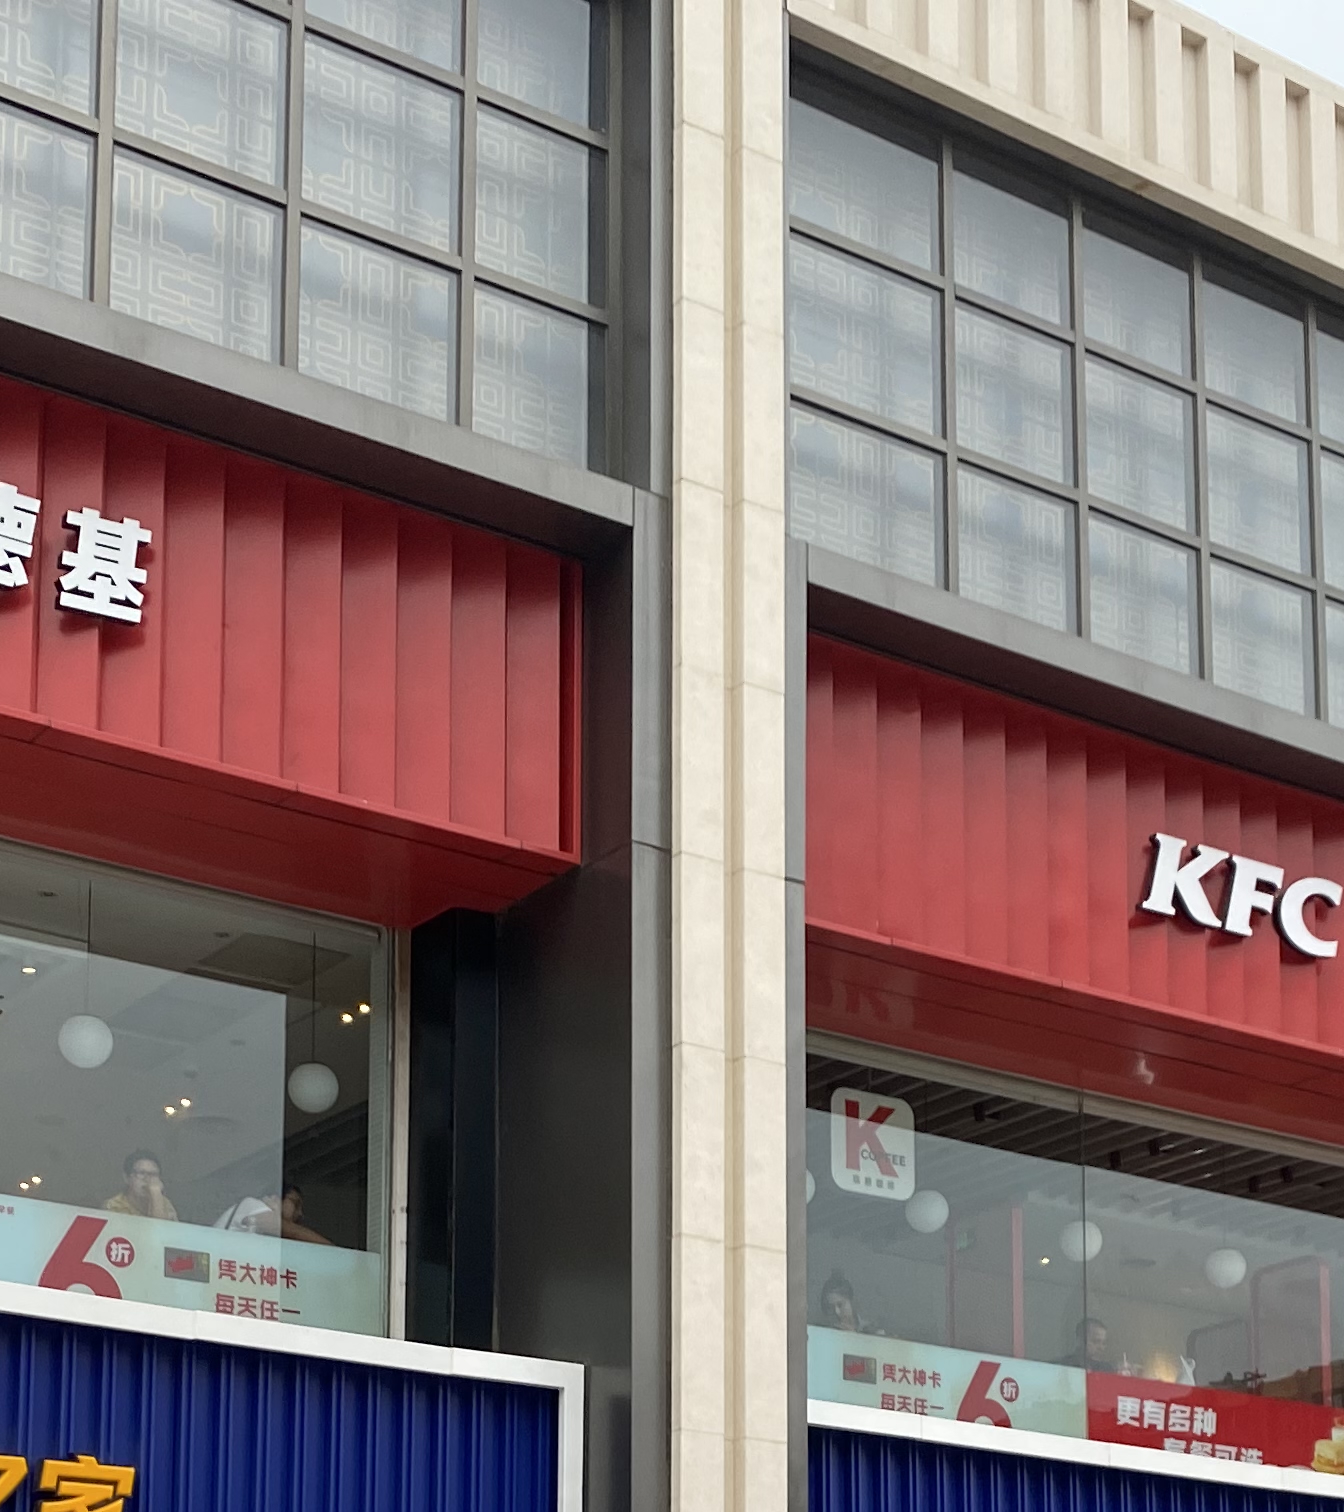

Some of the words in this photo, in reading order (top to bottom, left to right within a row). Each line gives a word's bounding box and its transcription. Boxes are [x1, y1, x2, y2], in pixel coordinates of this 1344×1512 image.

[1141, 832, 1343, 958] KFC
[844, 1098, 899, 1178] K
[860, 1148, 907, 1167] COFEE
[109, 1241, 131, 1264] 折
[217, 1258, 298, 1290] 凭大神卡
[215, 1292, 301, 1322] 每天任一
[1002, 1381, 1016, 1400] 折
[1117, 1395, 1217, 1437] 更有多种
